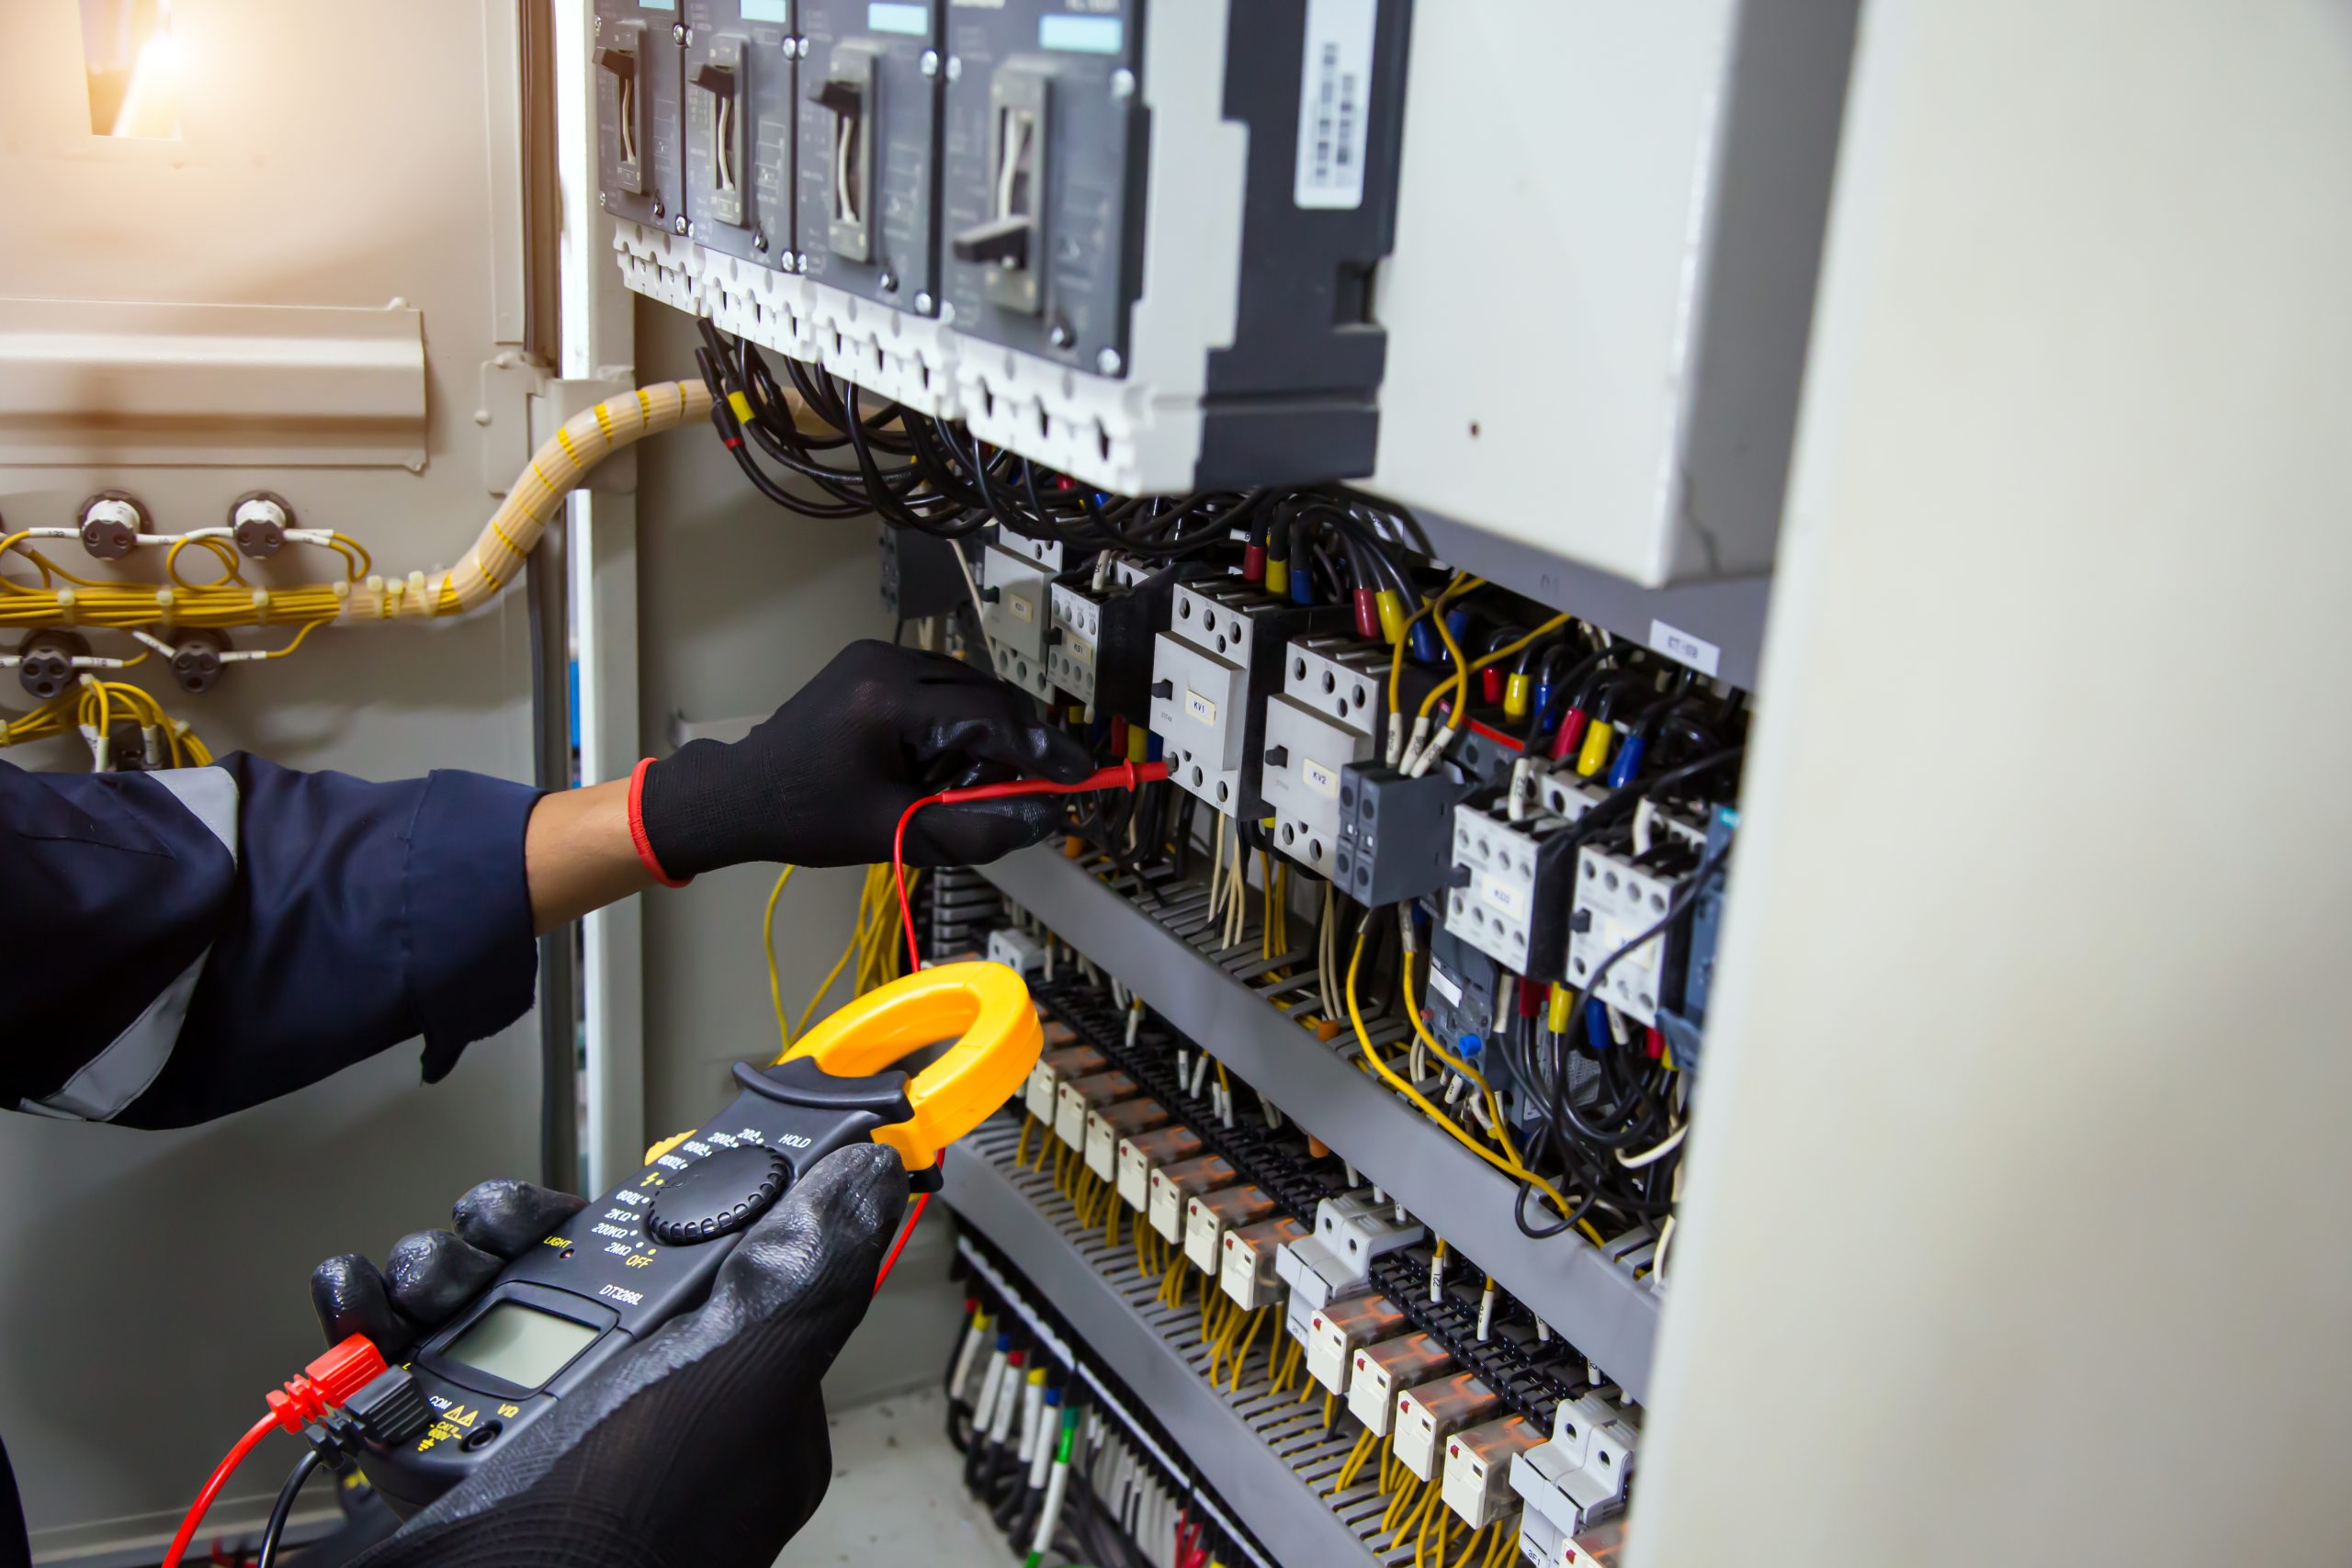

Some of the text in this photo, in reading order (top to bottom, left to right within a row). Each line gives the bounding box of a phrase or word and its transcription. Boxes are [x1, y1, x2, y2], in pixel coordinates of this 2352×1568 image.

[1193, 701, 1204, 714] KV1
[1313, 770, 1328, 785] KV2
[778, 1134, 812, 1148] HOLD
[543, 1235, 573, 1248] LIGHT
[625, 1255, 654, 1269] OFF
[1432, 1273, 1442, 1287] 221
[599, 1284, 644, 1305] DT3266L
[428, 1395, 453, 1410] COM
[1528, 1549, 1540, 1566] 3F1
